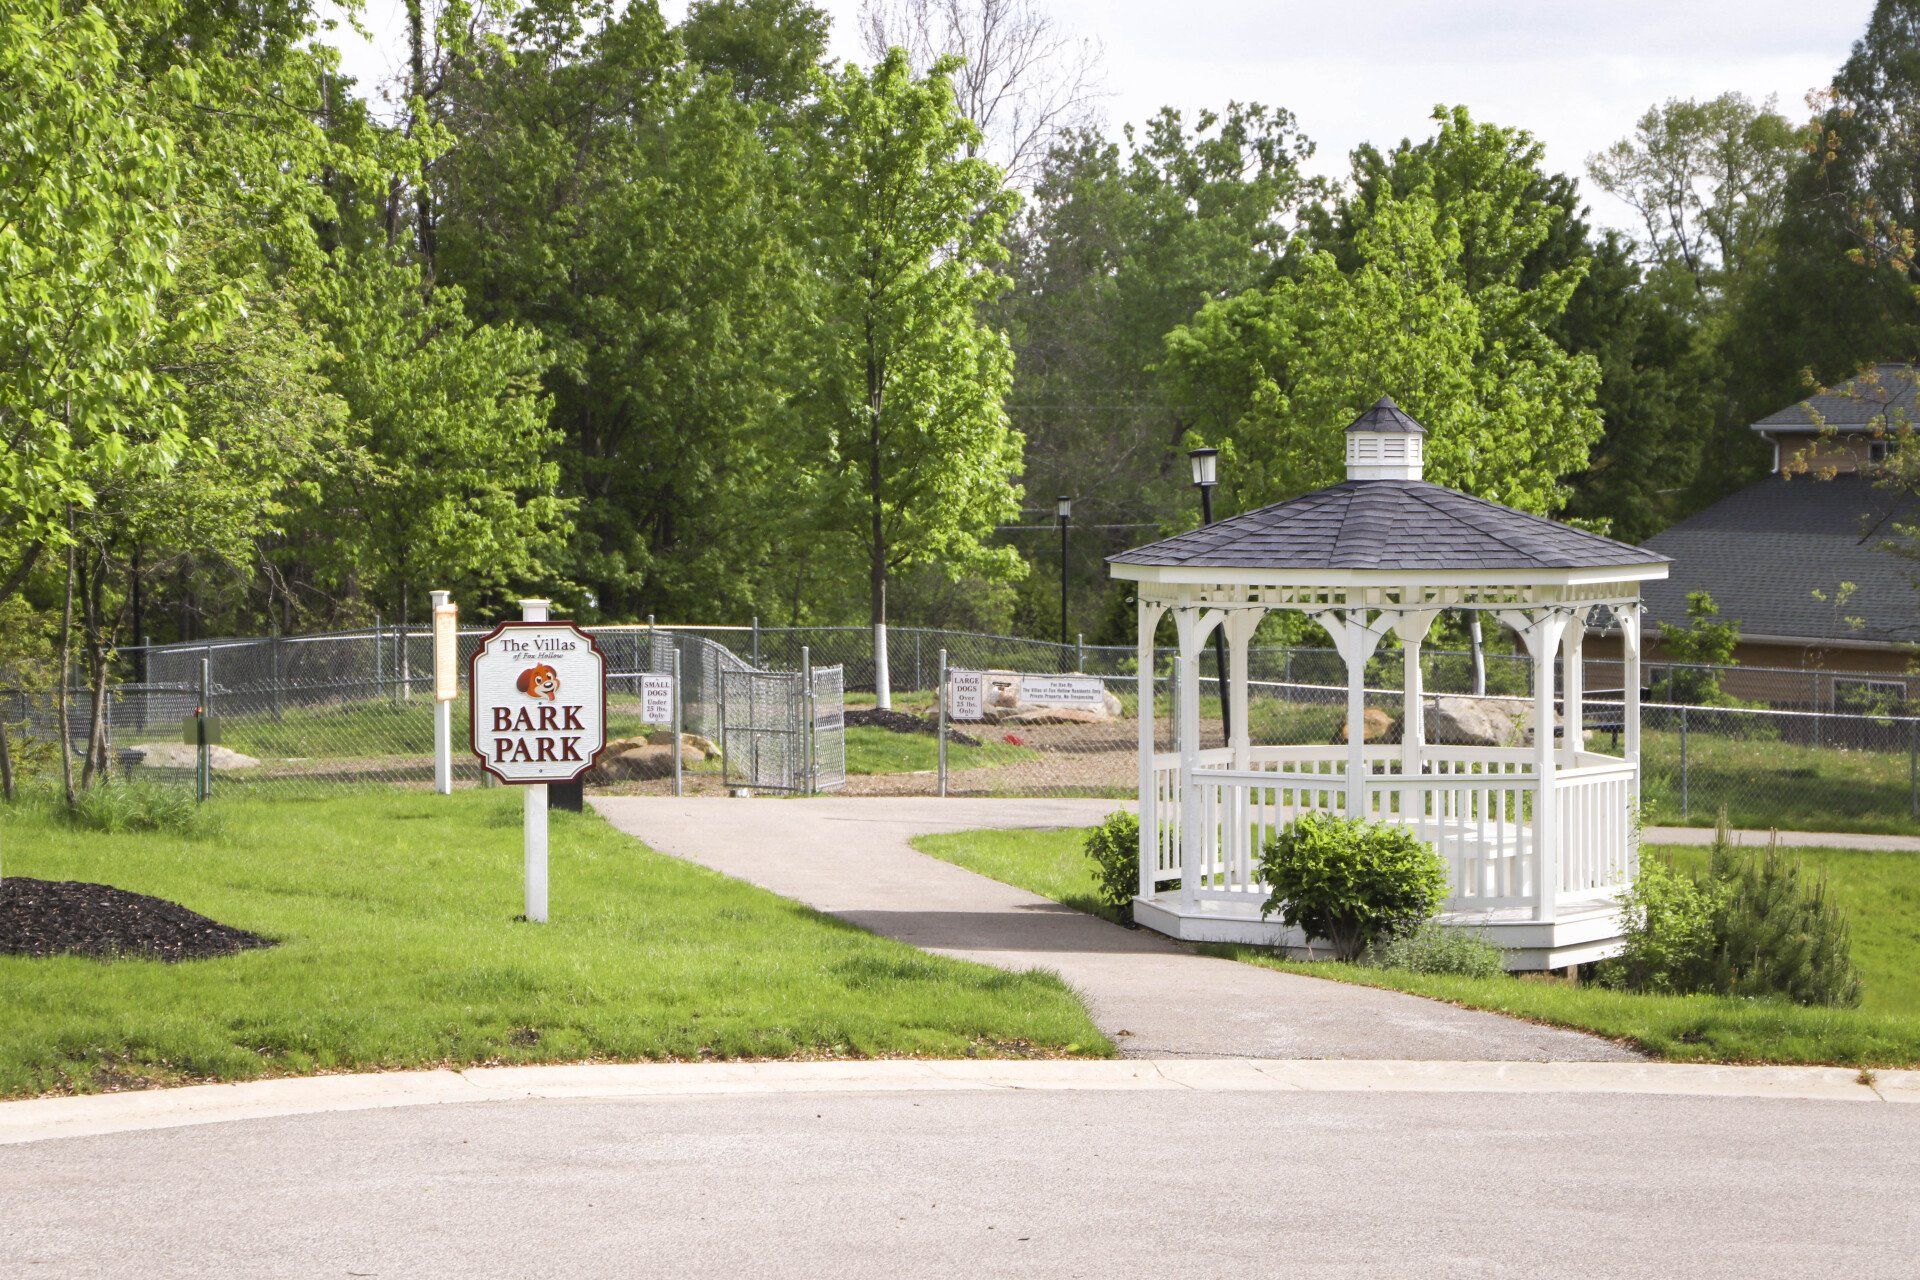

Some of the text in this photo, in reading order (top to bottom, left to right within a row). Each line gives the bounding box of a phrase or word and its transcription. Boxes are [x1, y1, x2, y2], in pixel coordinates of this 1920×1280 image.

[500, 638, 576, 651] The Villas
[512, 652, 522, 661] of
[492, 706, 585, 732] BARK
[494, 737, 584, 762] PARK
